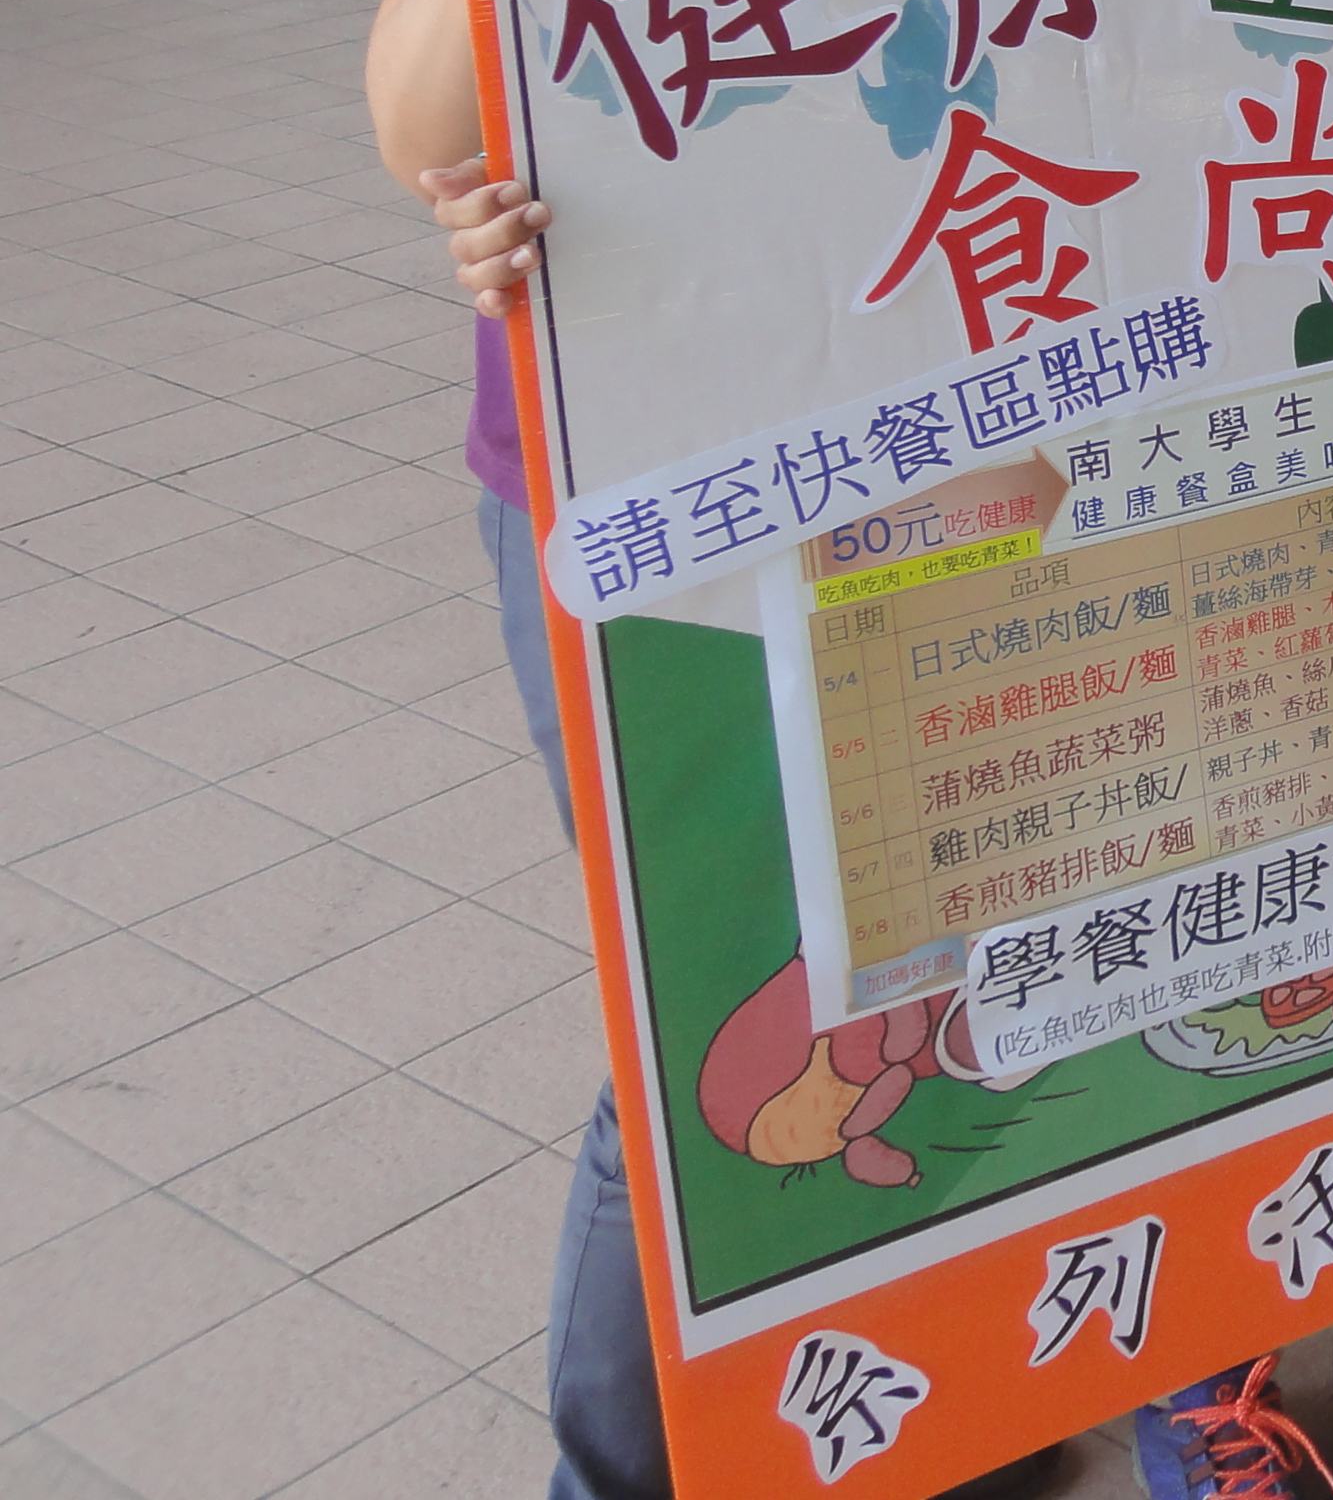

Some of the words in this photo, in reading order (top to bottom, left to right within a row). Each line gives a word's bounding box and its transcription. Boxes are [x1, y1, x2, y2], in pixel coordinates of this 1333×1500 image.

[571, 295, 1213, 603] 請至快餐區點購
[1010, 558, 1070, 599] 品項
[824, 604, 886, 643] 日期
[911, 582, 1172, 681] 日式燒肉飯/麵
[823, 671, 858, 692] 5/4
[831, 738, 866, 760] 5/5
[840, 803, 875, 826] 5/6
[847, 861, 879, 884] 5/7
[854, 918, 889, 941] 5/8
